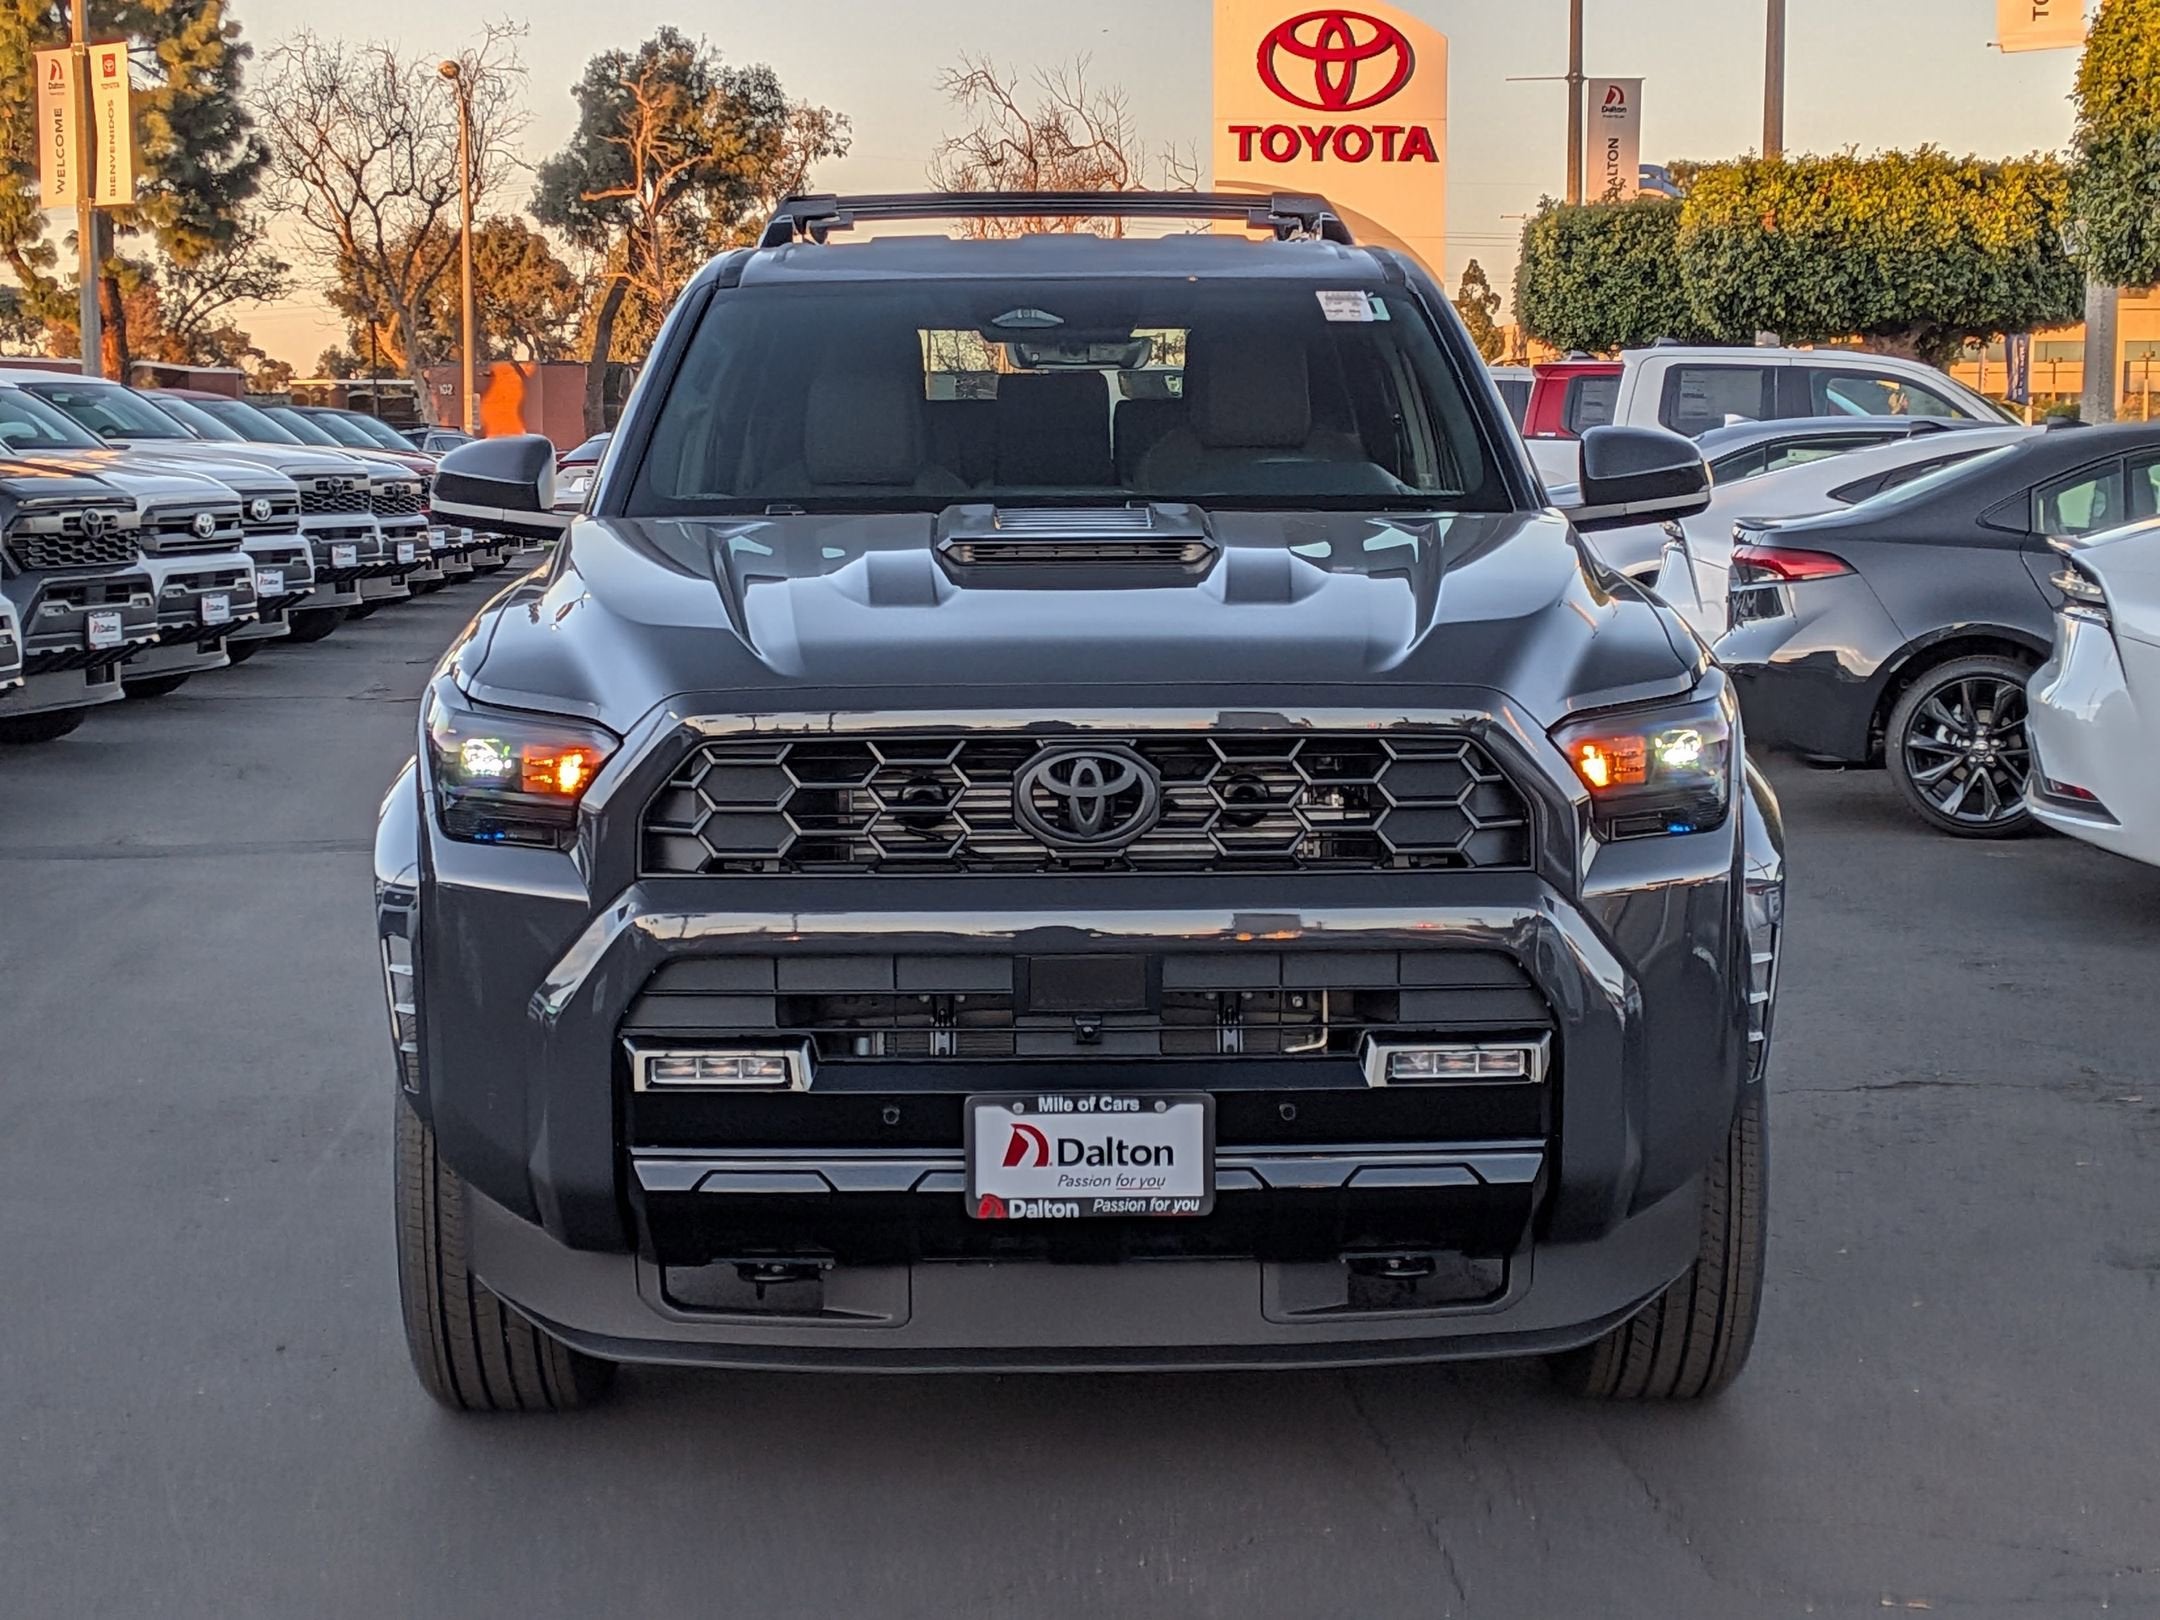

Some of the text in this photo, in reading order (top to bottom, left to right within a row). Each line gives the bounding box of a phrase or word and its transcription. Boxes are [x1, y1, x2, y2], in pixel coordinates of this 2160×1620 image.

[1601, 105, 1627, 113] Dalton
[54, 108, 66, 194] WELCOME
[107, 99, 116, 197] BIENVENIDOS
[1228, 124, 1440, 163] TOYOTA
[1038, 1095, 1140, 1113] Mile of Cars
[1057, 1136, 1174, 1167] Dalton
[1057, 1173, 1166, 1188] Passion for you
[1009, 1200, 1080, 1219] Dalton
[1092, 1199, 1200, 1213] Passion for you
